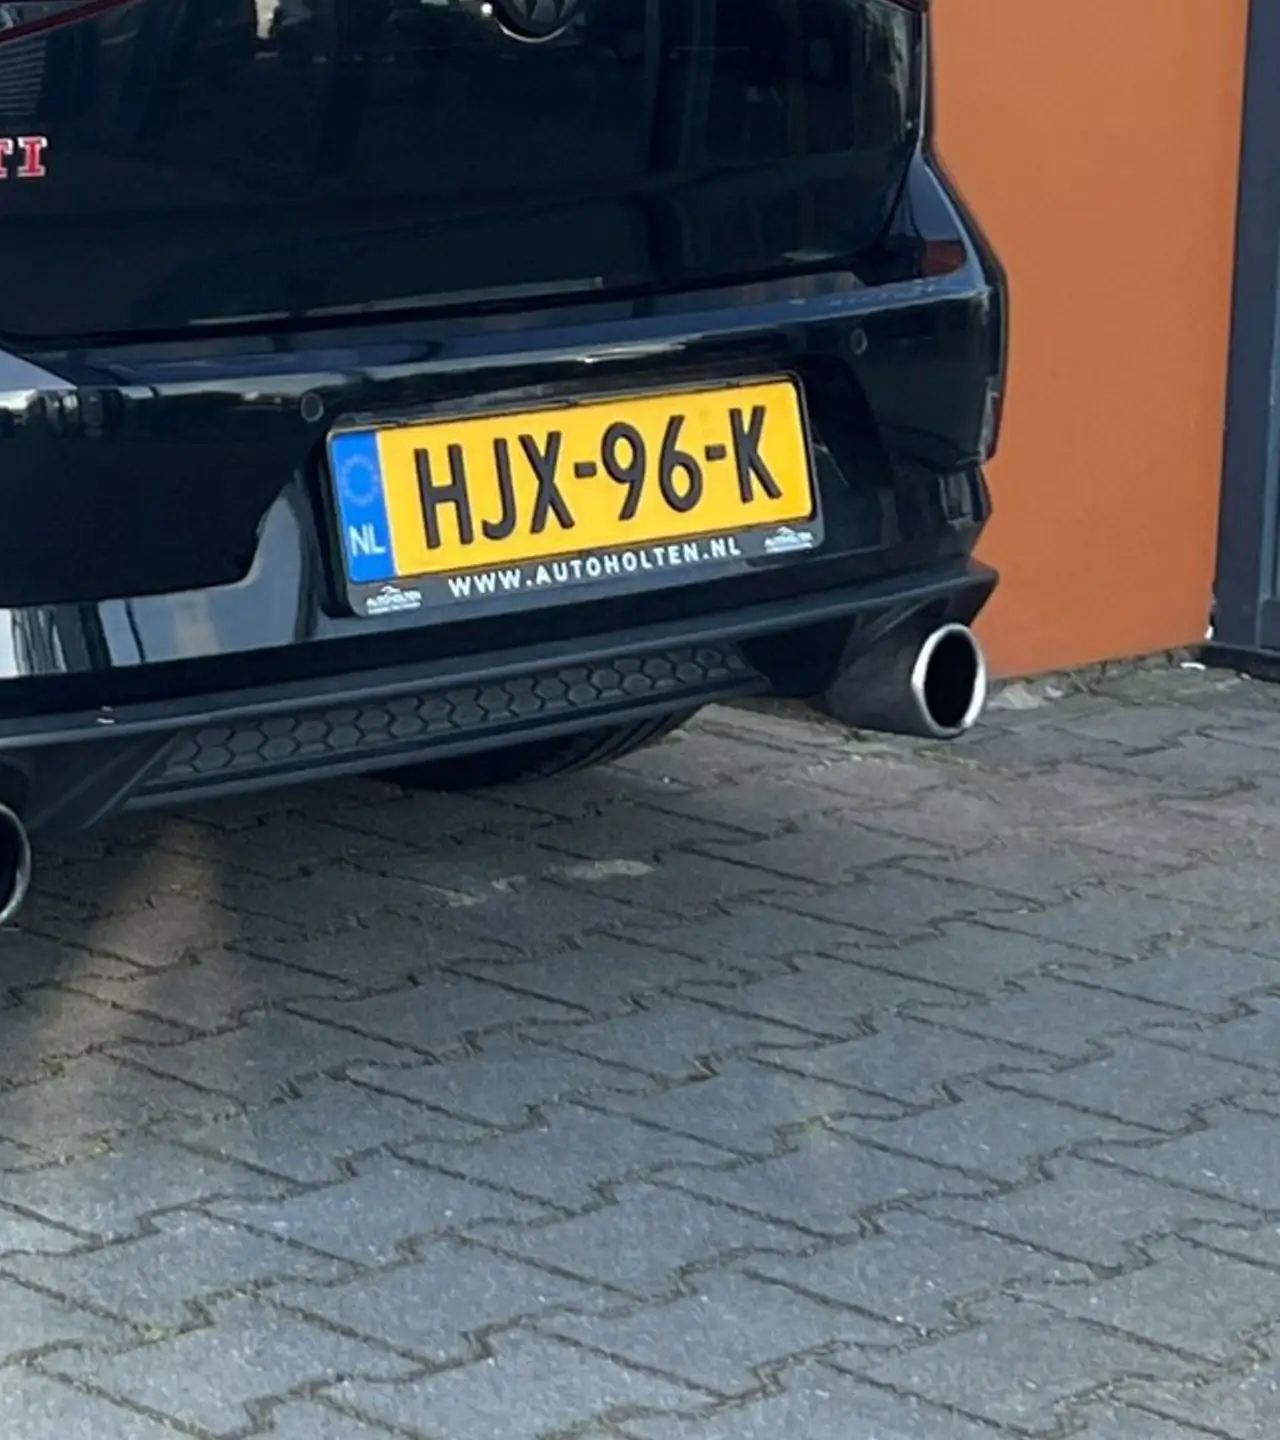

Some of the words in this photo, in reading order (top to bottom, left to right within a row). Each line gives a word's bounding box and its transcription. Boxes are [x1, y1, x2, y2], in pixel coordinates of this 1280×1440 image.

[414, 405, 783, 550] HJX-96-K
[349, 524, 385, 556] NL
[448, 537, 741, 599] WWW.AUTOHOLTEN.NL
